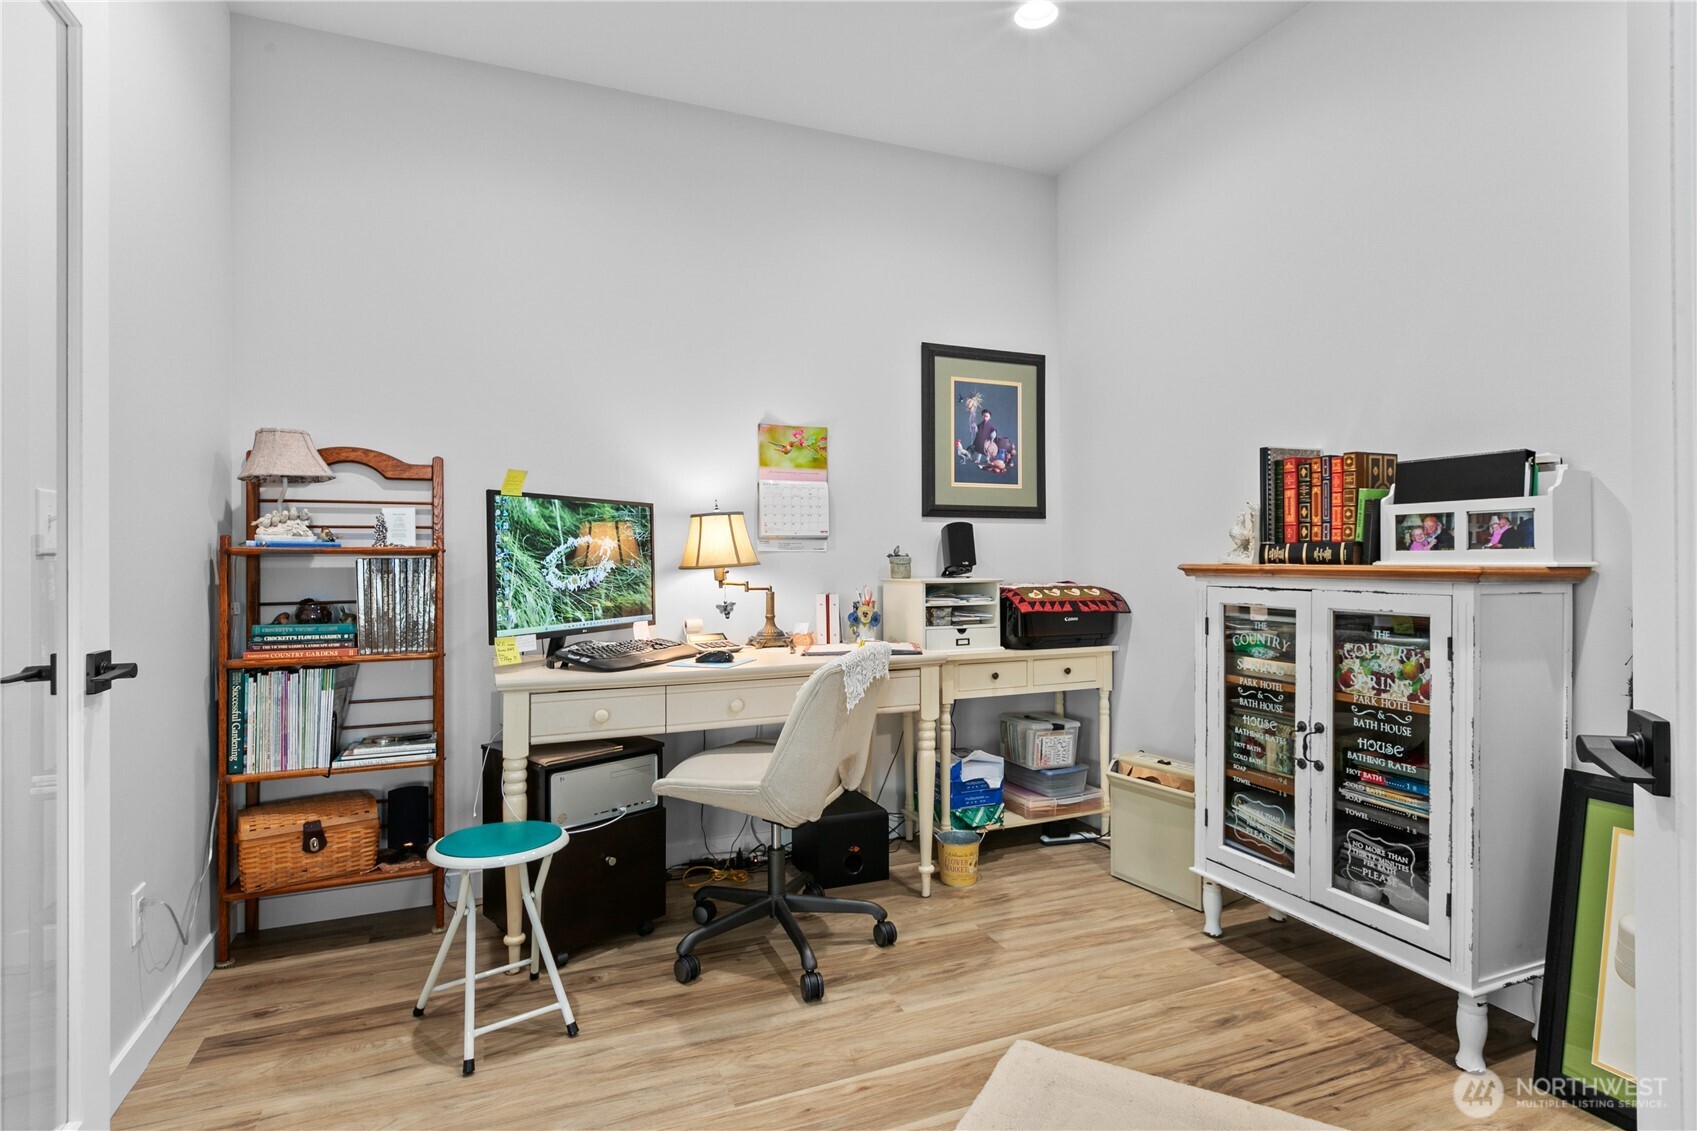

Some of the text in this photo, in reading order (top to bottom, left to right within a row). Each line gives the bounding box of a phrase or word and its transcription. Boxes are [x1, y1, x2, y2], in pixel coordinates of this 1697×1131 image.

[1254, 622, 1267, 630] THE
[1232, 633, 1290, 652] COUNTRY
[1372, 630, 1390, 639] THE
[1240, 677, 1283, 692] PARK HOTEL
[1258, 691, 1264, 699] &
[1353, 694, 1412, 712] PARK HOTEL
[232, 686, 241, 722] Successful
[1240, 697, 1283, 713] BATH HOUSE
[1378, 710, 1385, 720] &
[1353, 717, 1412, 737] BATH HOUSE
[229, 723, 241, 761] Gardening
[1235, 726, 1286, 745] BATHING RATES
[1233, 753, 1248, 761] COLD
[1347, 751, 1417, 774] BATHING RATES
[1232, 776, 1251, 787] TOWEL
[1346, 768, 1361, 776] HOT
[1363, 772, 1382, 782] BATH
[1345, 808, 1369, 820] TOWEL
[1352, 840, 1408, 864] NO MORE THAN
[945, 857, 968, 866] FLOWER
[1352, 848, 1409, 873] THIRTY MINUTES
[1364, 859, 1396, 875] PER BATH
[944, 865, 968, 873] MARKET
[1362, 867, 1397, 887] PLEASE
